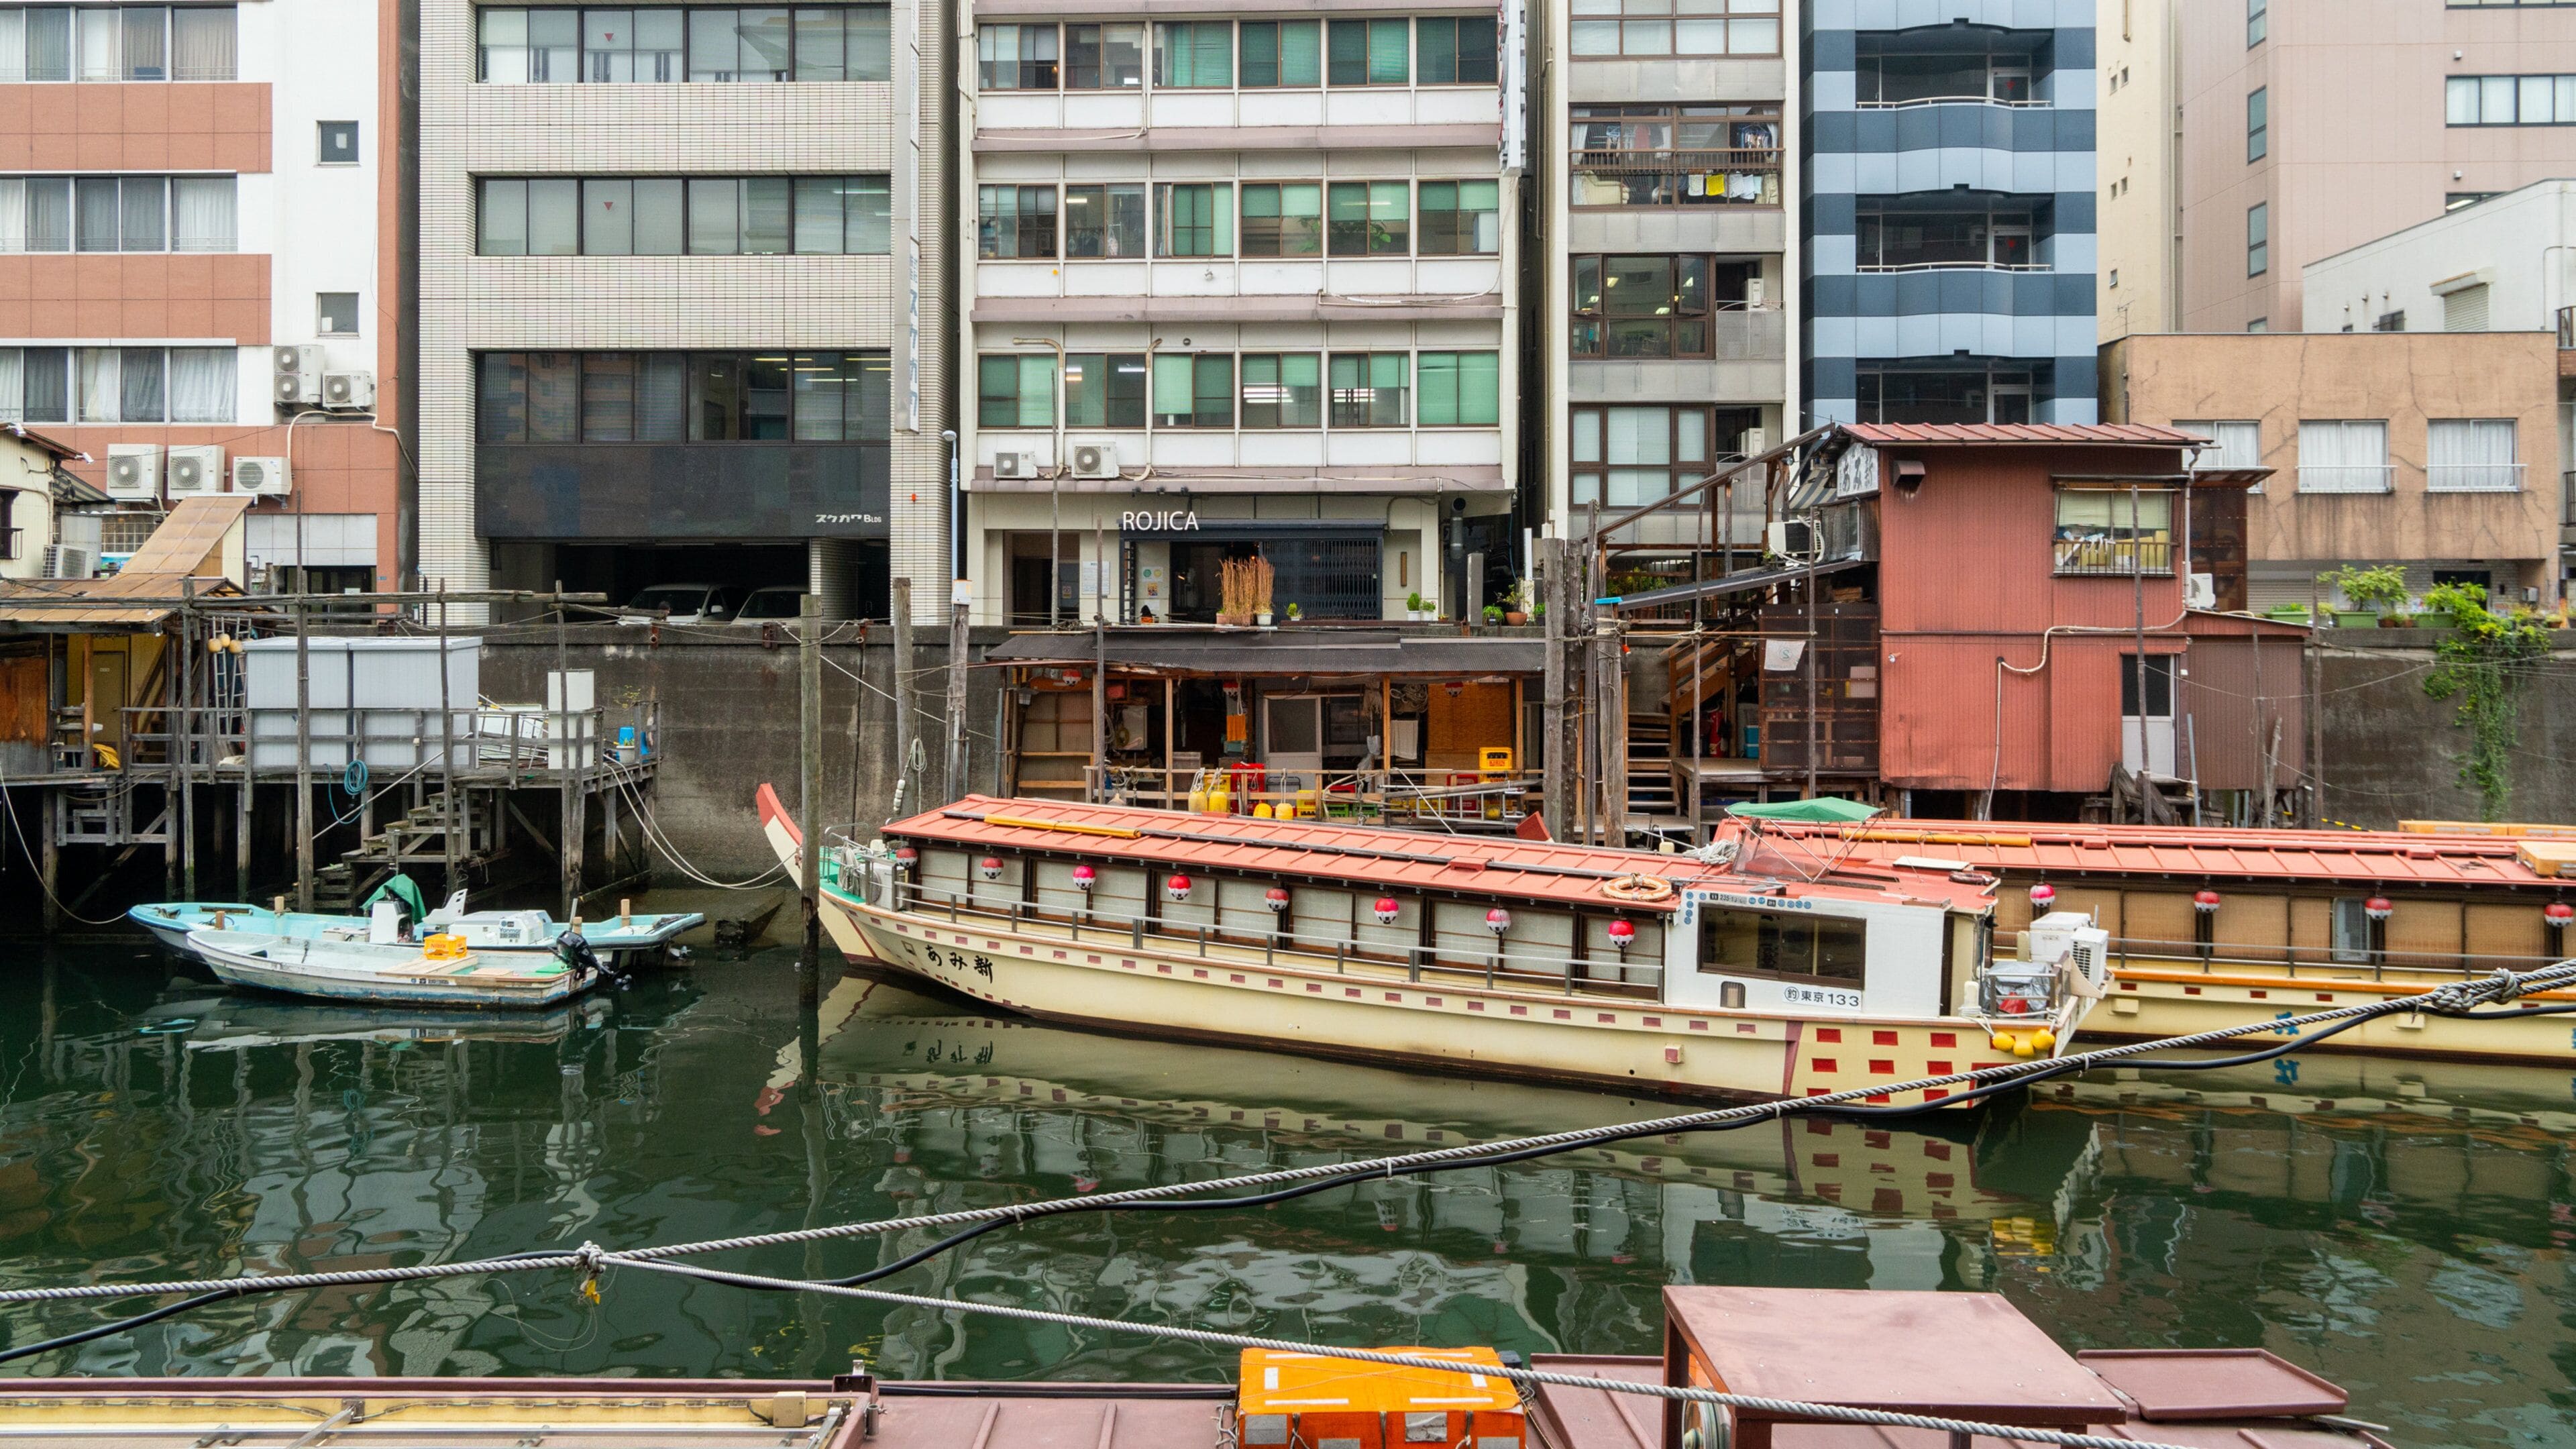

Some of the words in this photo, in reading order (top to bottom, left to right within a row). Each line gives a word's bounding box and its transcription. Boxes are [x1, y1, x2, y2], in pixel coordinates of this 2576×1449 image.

[815, 514, 862, 523] スクガワ
[1122, 511, 1199, 531] ROJICA
[924, 944, 994, 984] あみ新
[1801, 990, 1824, 1003] 東京
[1827, 993, 1859, 1007] 133
